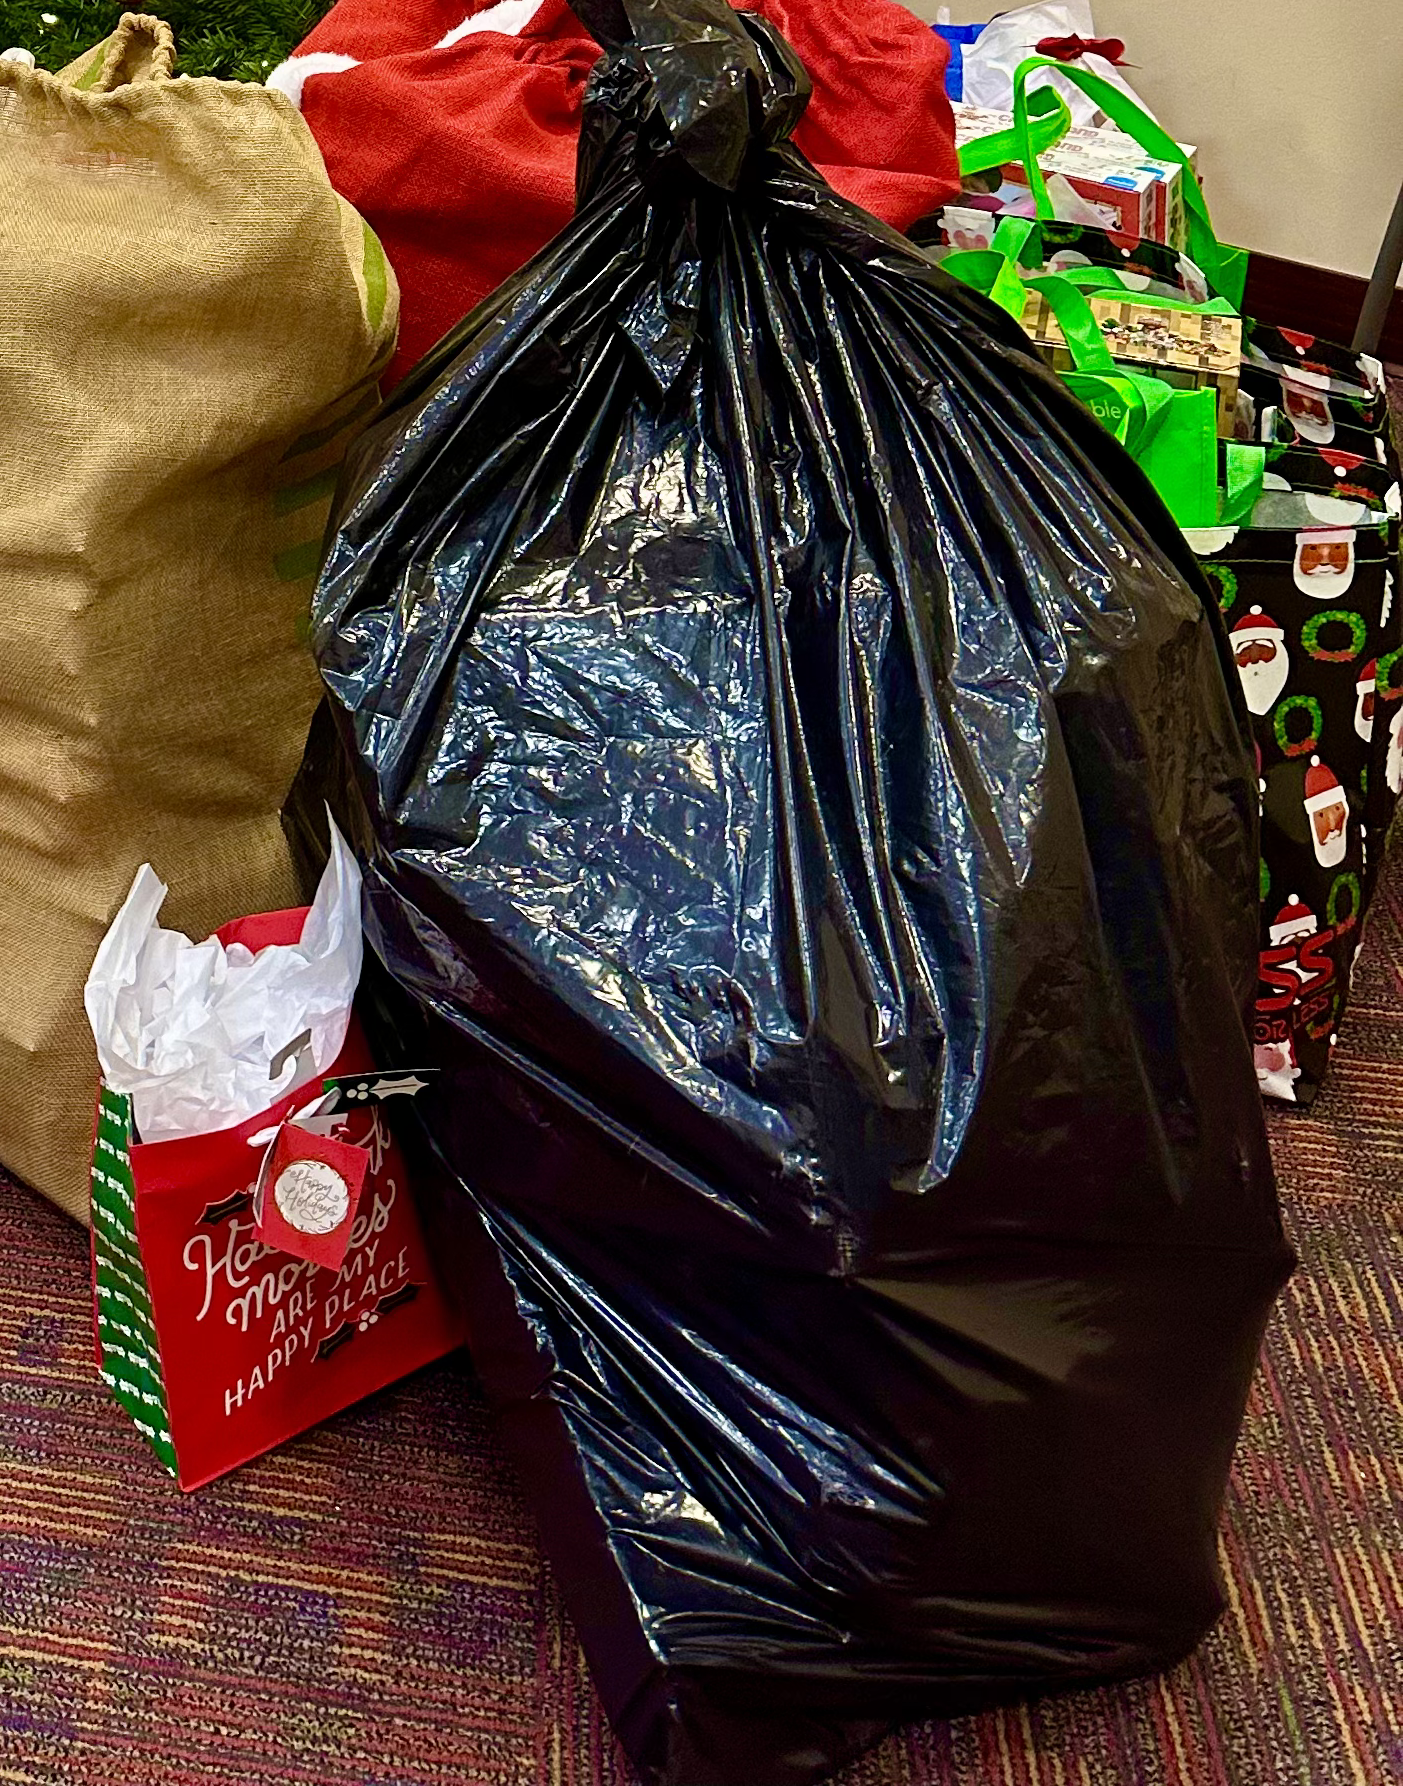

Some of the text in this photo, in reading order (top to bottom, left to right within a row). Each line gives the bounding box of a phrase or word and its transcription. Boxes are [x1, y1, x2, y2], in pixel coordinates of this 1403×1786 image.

[285, 1169, 340, 1203] Happy
[224, 1245, 410, 1417] HAPPY PLACE
[269, 1237, 380, 1343] ARE MY
